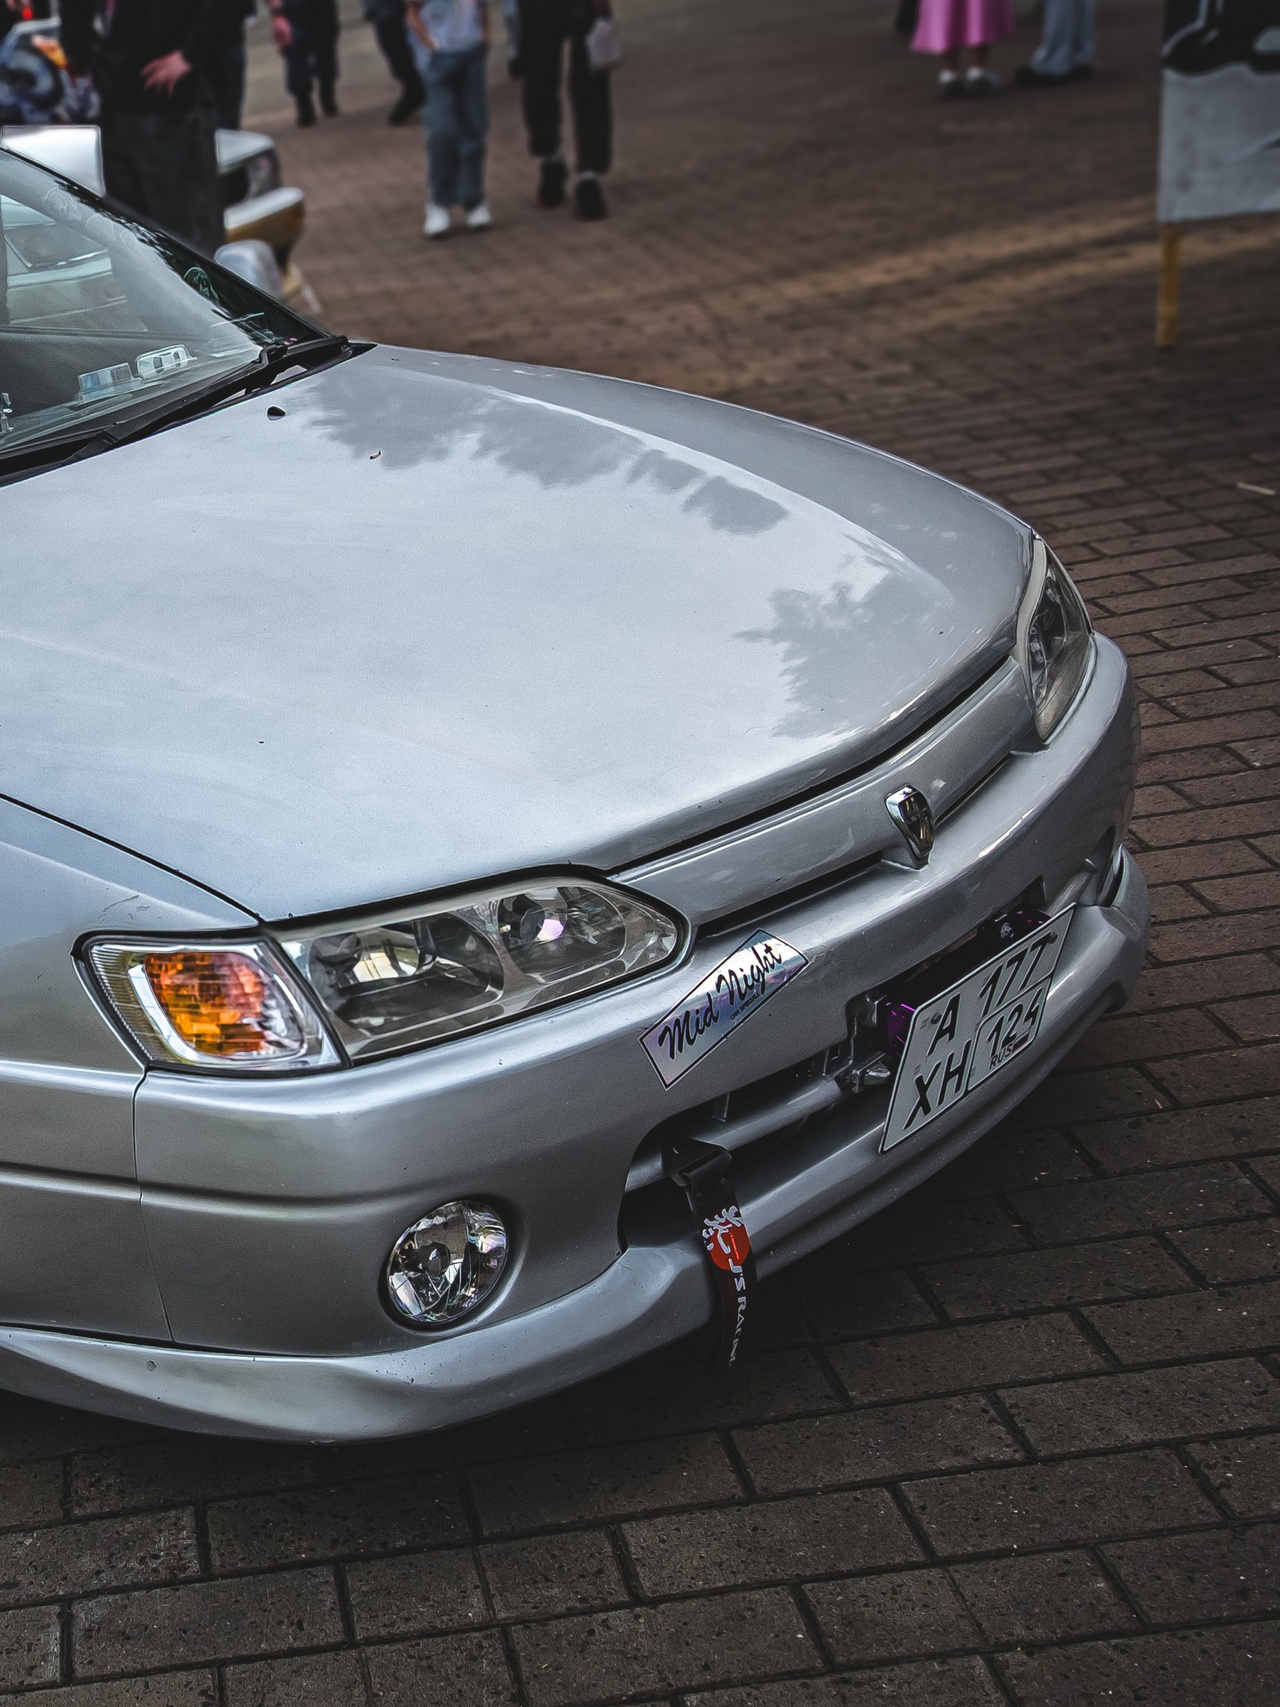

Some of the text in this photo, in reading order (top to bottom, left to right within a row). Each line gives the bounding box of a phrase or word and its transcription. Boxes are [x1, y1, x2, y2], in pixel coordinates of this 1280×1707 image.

[658, 943, 782, 1059] Mid Night
[978, 931, 1052, 1018] 177
[986, 987, 1044, 1057] 124
[989, 1043, 1014, 1070] RUS
